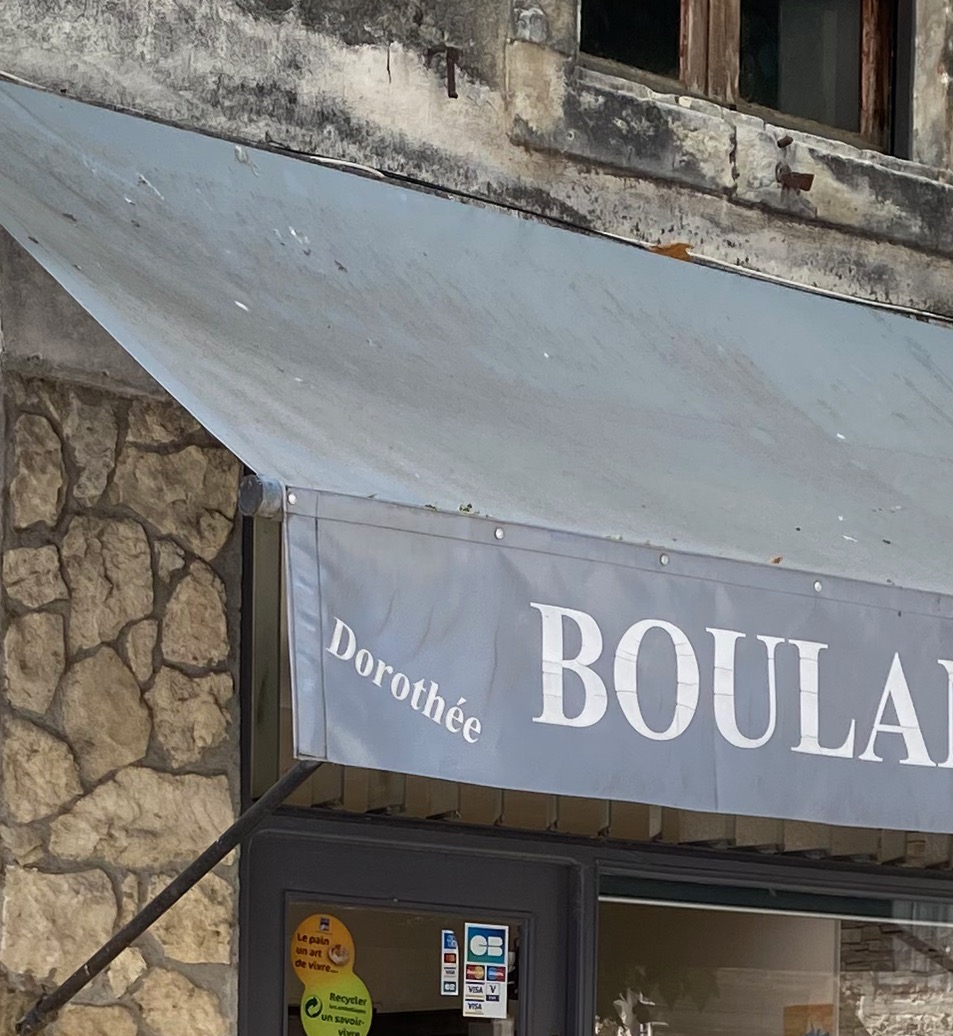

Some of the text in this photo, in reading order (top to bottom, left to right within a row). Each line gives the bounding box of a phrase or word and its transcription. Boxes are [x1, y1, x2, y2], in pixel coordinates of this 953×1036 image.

[325, 616, 484, 744] Dorothée
[297, 932, 308, 942] Le
[309, 936, 330, 946] pain
[296, 947, 322, 958] un art
[295, 959, 306, 969] de
[468, 986, 483, 994] VISA
[329, 992, 367, 1006] Recycler
[467, 1003, 483, 1011] VISA
[321, 1014, 333, 1022] un
